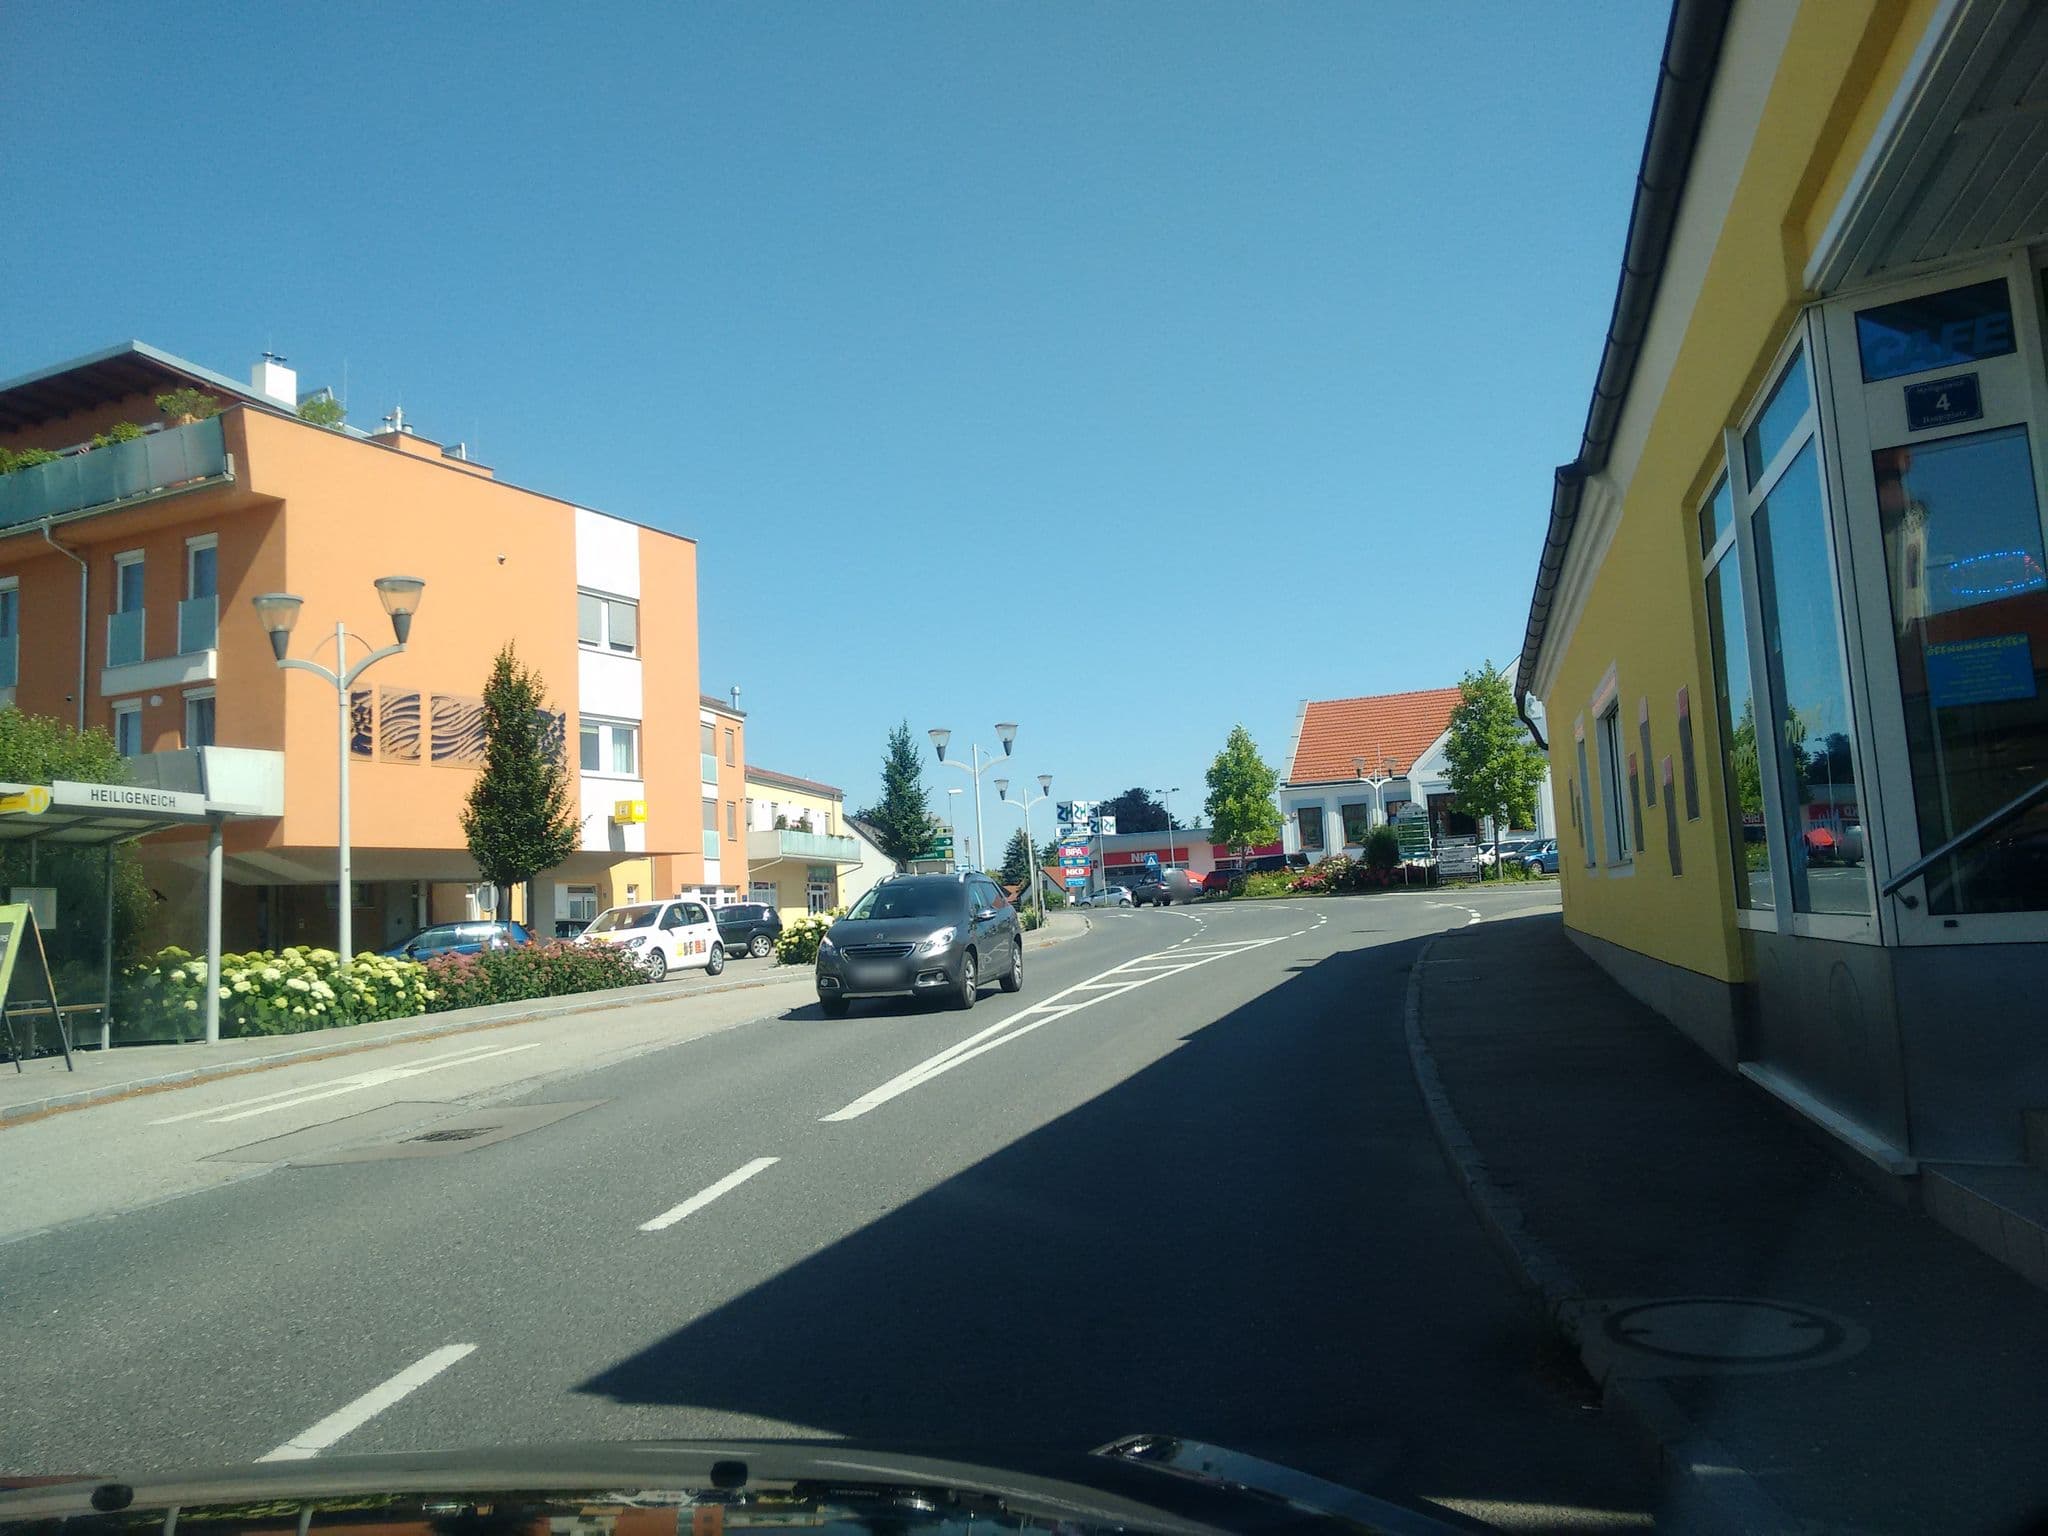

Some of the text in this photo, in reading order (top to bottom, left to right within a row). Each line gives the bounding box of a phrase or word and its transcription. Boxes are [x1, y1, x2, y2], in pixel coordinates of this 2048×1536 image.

[1936, 393, 1951, 411] 4
[90, 788, 176, 808] HEILIGENEICH
[1065, 847, 1083, 856] BIPA
[1066, 867, 1084, 876] NKD
